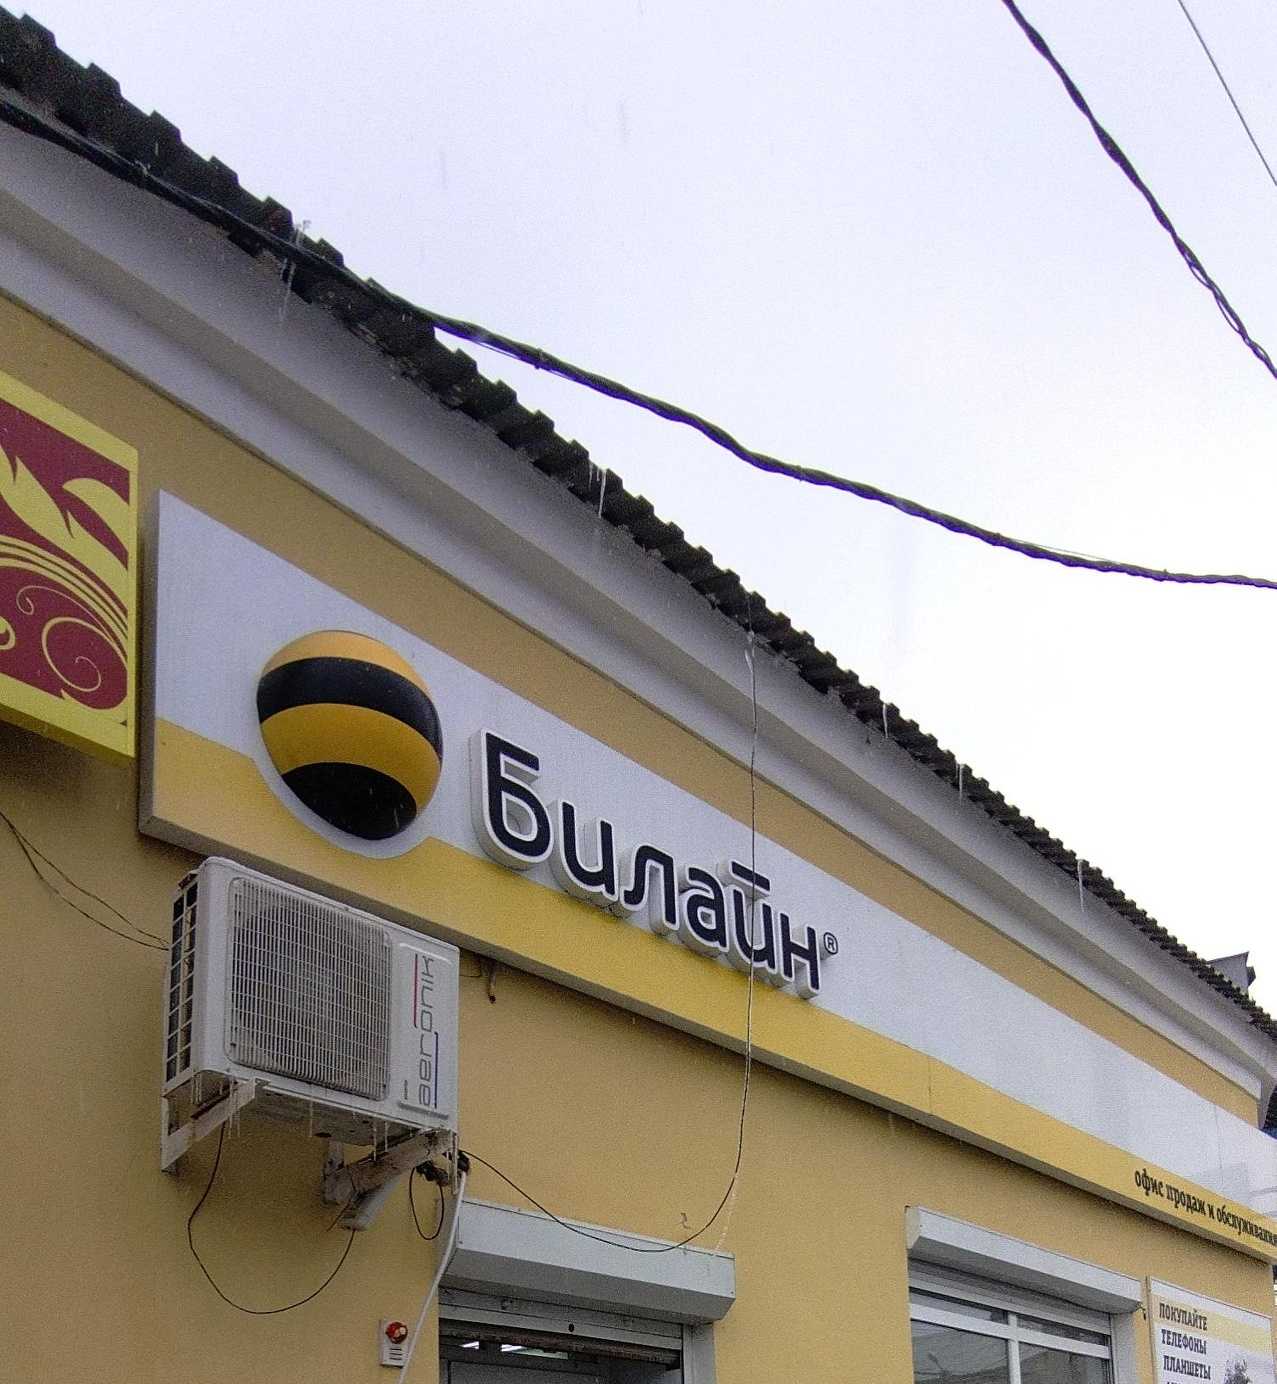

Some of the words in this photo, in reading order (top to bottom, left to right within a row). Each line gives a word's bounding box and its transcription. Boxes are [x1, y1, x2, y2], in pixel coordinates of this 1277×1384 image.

[1134, 1168, 1164, 1197] офис
[1166, 1184, 1207, 1216] продаж
[1207, 1203, 1215, 1220] и
[1159, 1302, 1208, 1331] ПОКУПАЙТЕ
[1161, 1328, 1207, 1355] ТЕЛЕФОНЫ
[1163, 1355, 1211, 1381] ПЛАНШЕТЫ
